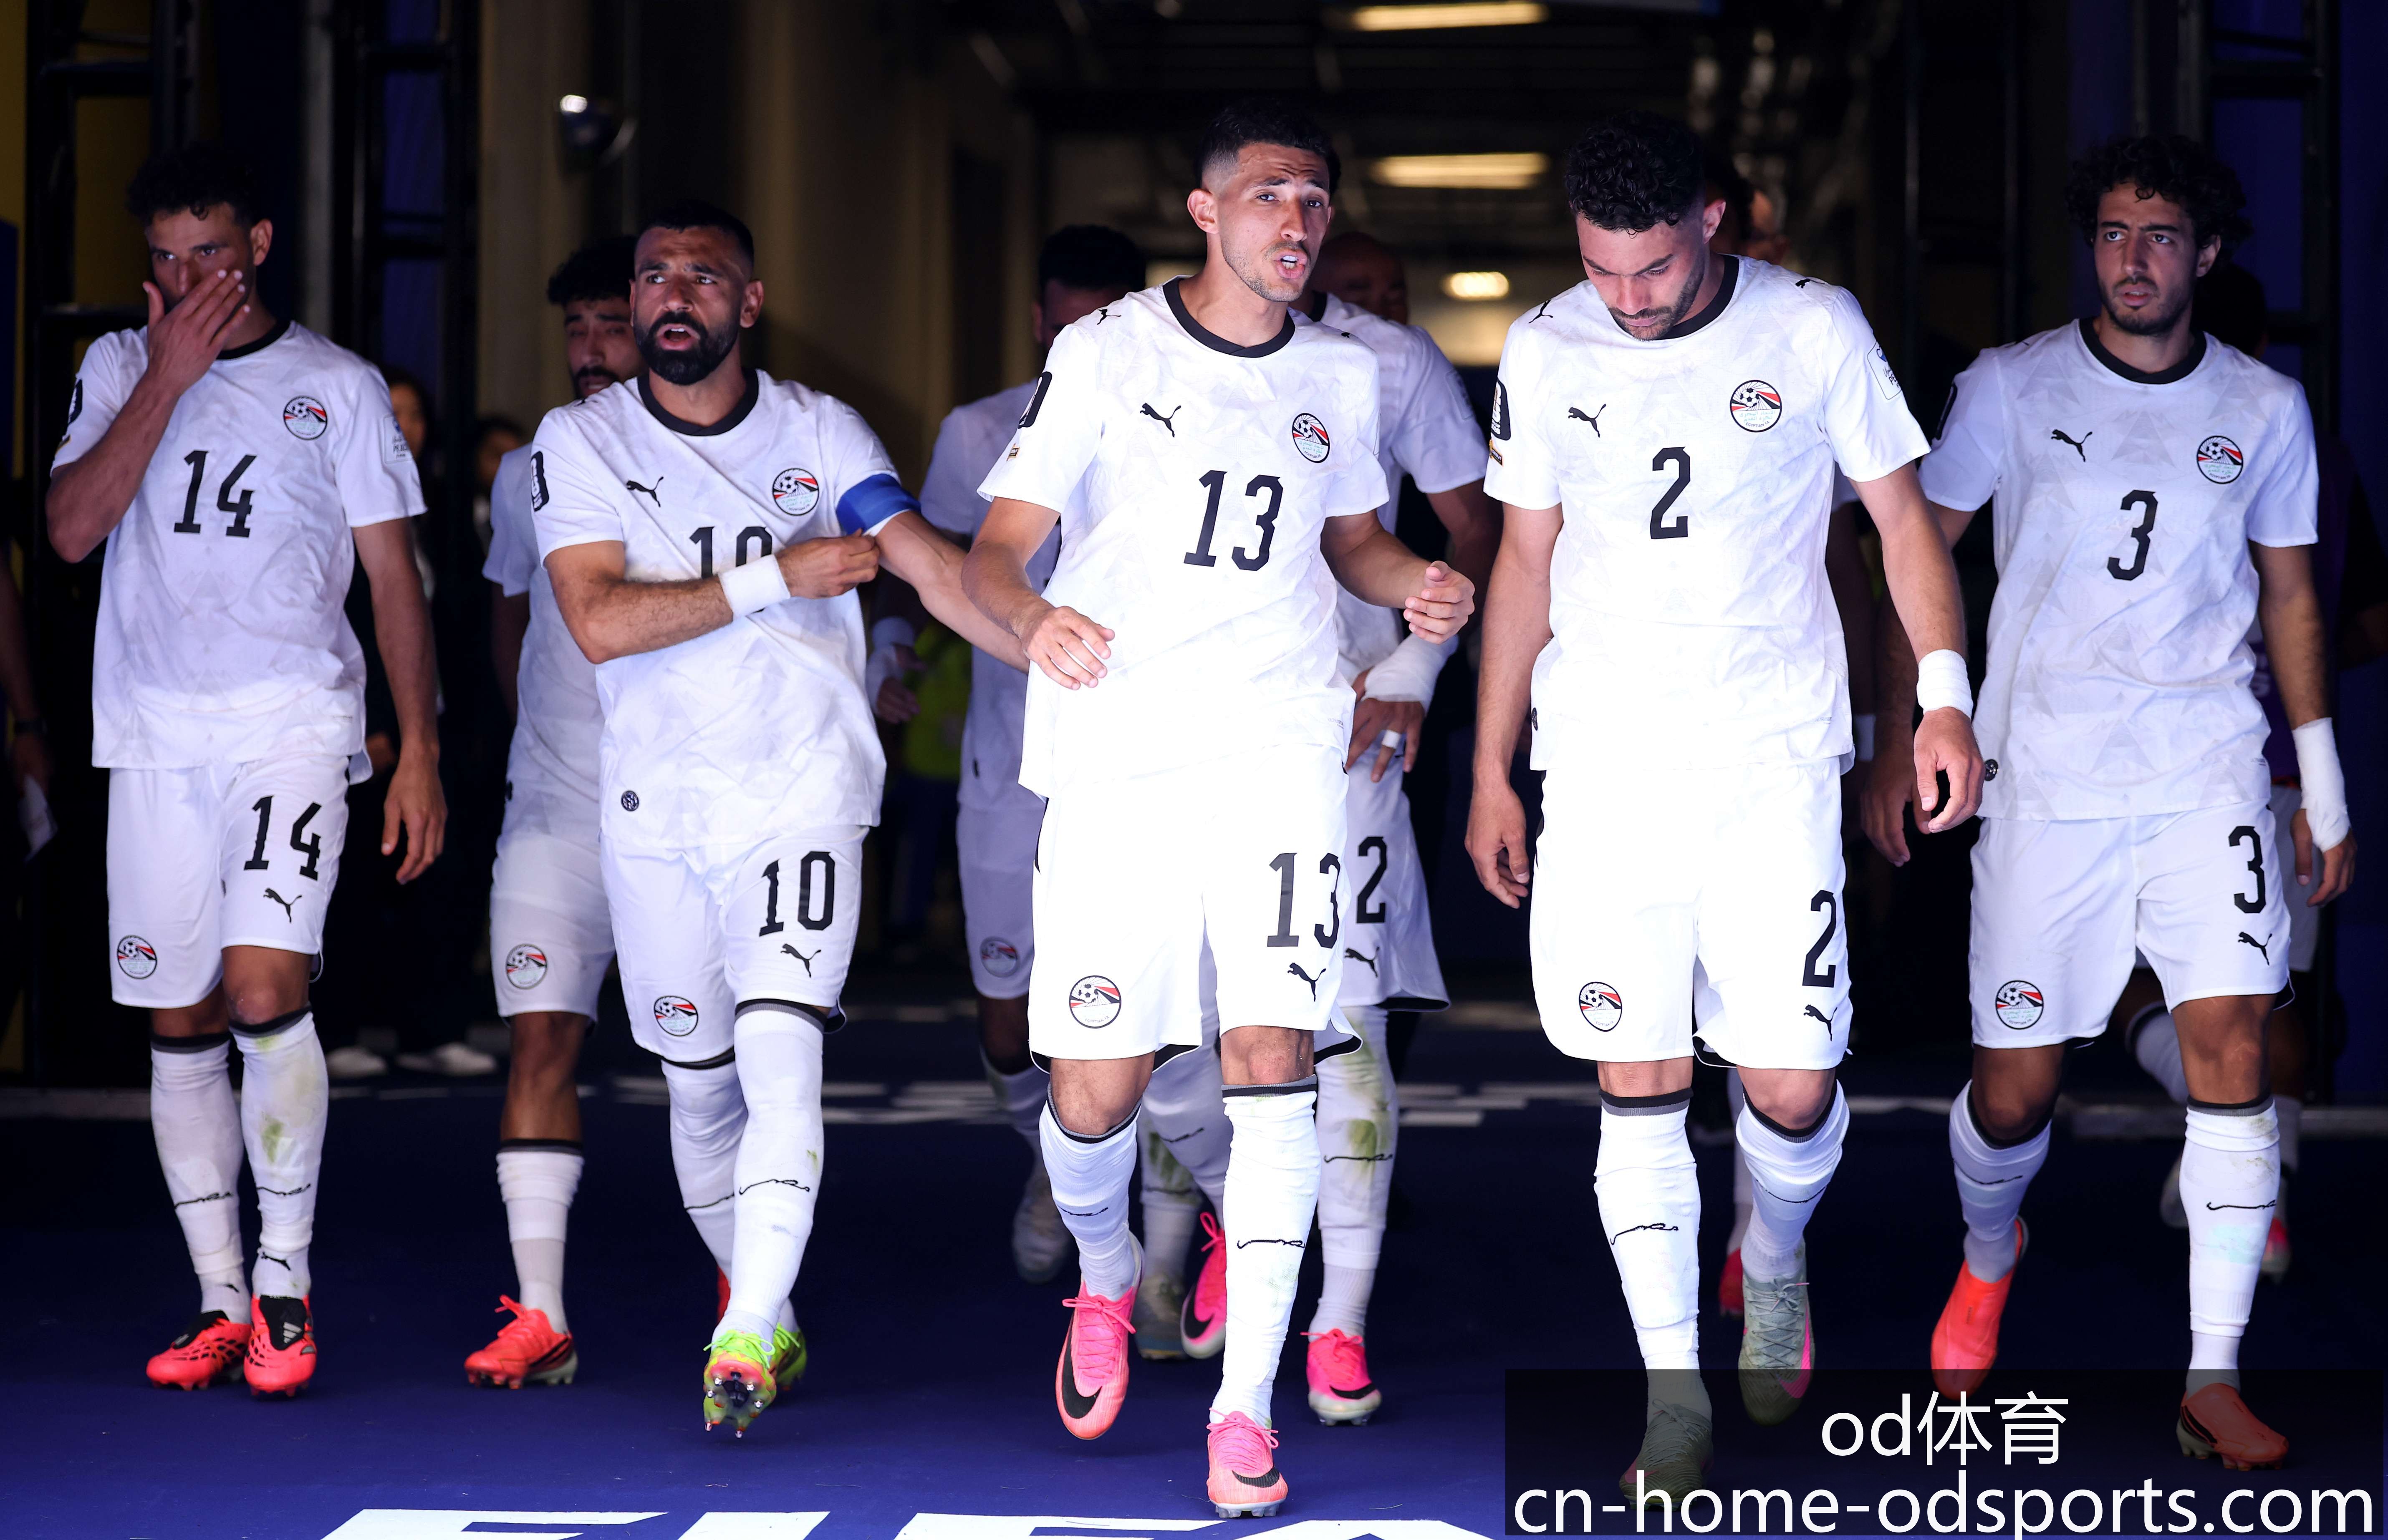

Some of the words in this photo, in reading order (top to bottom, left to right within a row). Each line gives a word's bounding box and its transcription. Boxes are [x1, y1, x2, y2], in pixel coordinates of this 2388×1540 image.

[174, 450, 257, 538] 14
[1184, 470, 1283, 571] 13
[1650, 446, 1691, 539] 2
[2107, 490, 2158, 581] 3
[244, 796, 322, 881] 14
[2228, 826, 2267, 914] 3
[759, 851, 835, 937] 10
[1267, 852, 1340, 949] 13
[1802, 890, 1837, 988] 2
